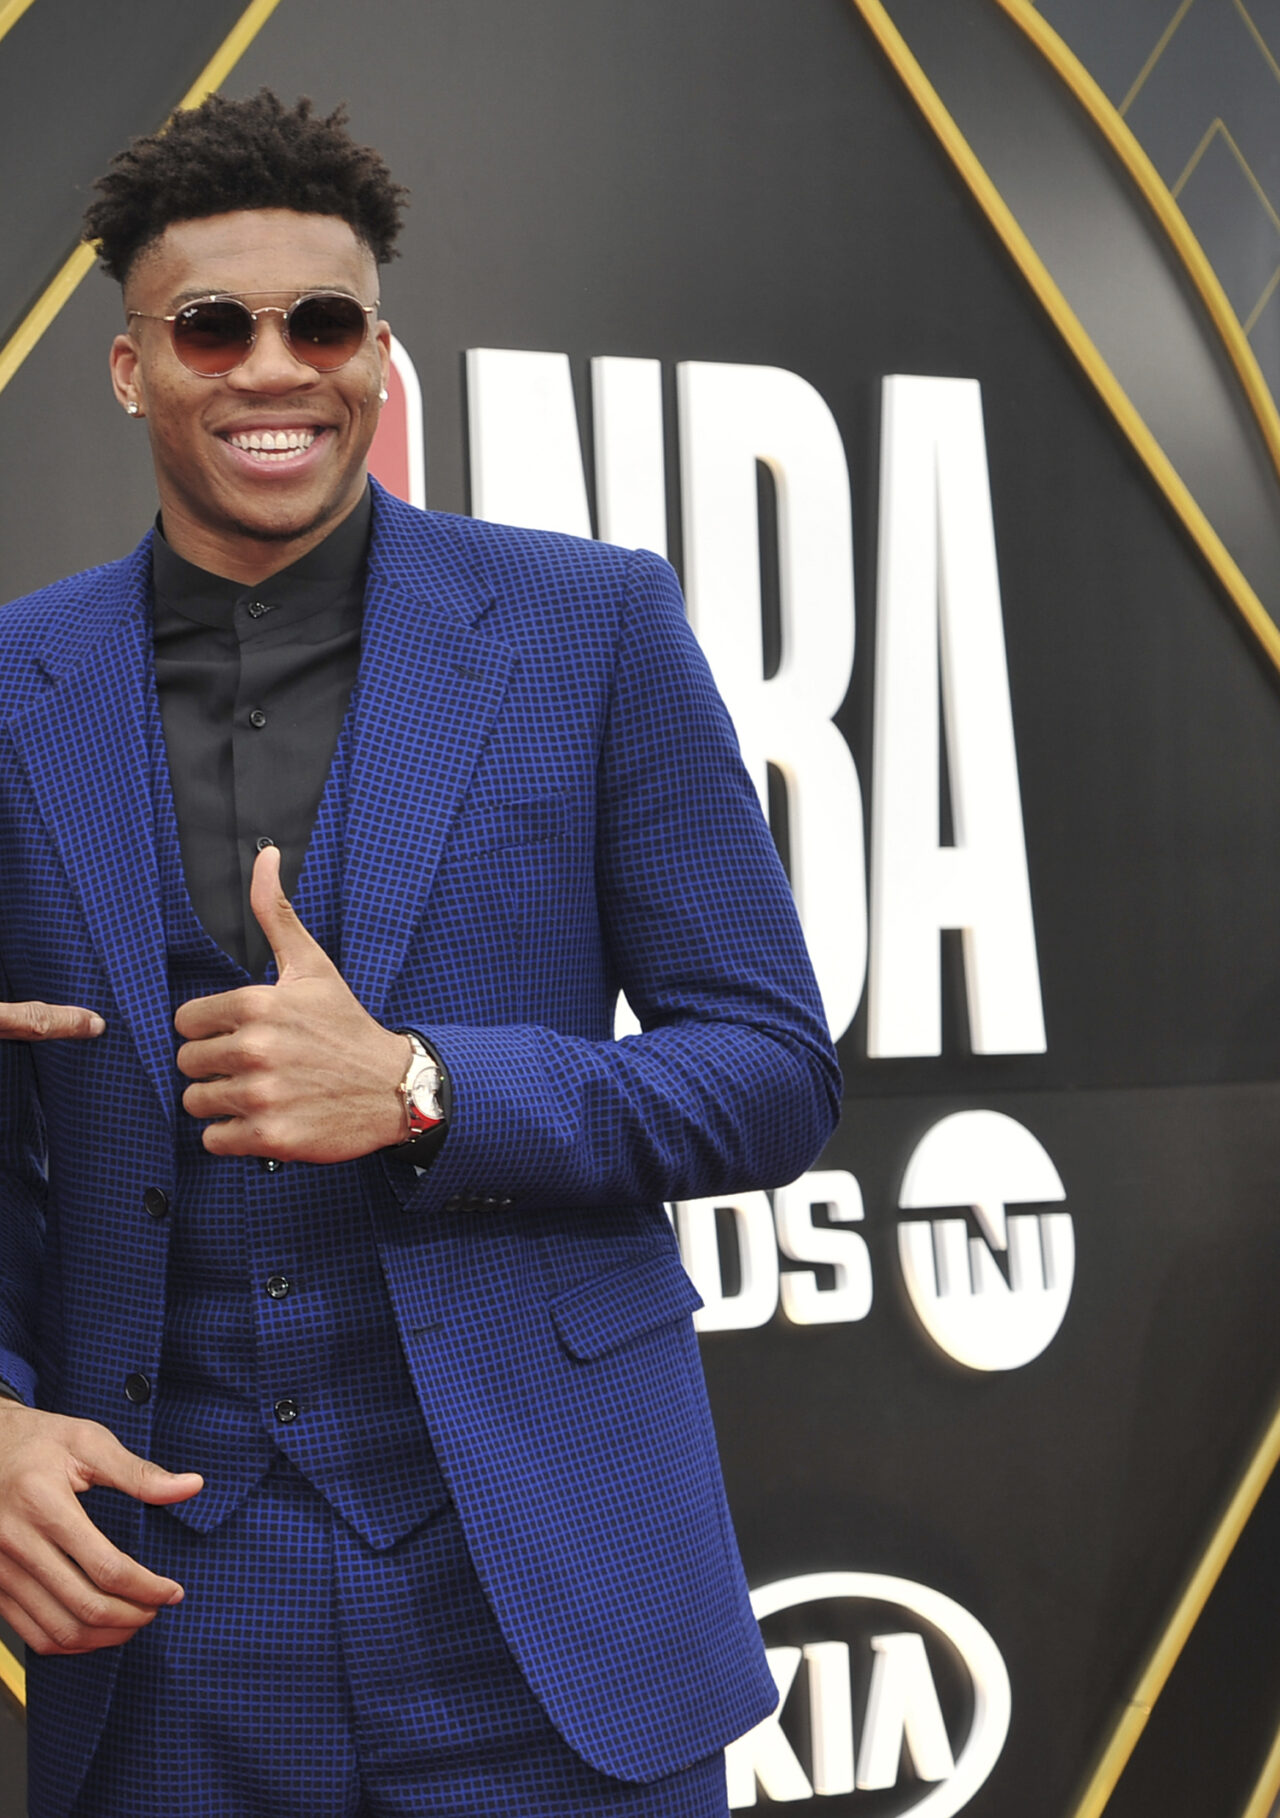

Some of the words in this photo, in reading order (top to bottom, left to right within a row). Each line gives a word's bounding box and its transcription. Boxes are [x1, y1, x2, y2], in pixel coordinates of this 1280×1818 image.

[466, 346, 1047, 1058] BA
[664, 1169, 873, 1332] DS
[724, 1632, 955, 1810] KIA
